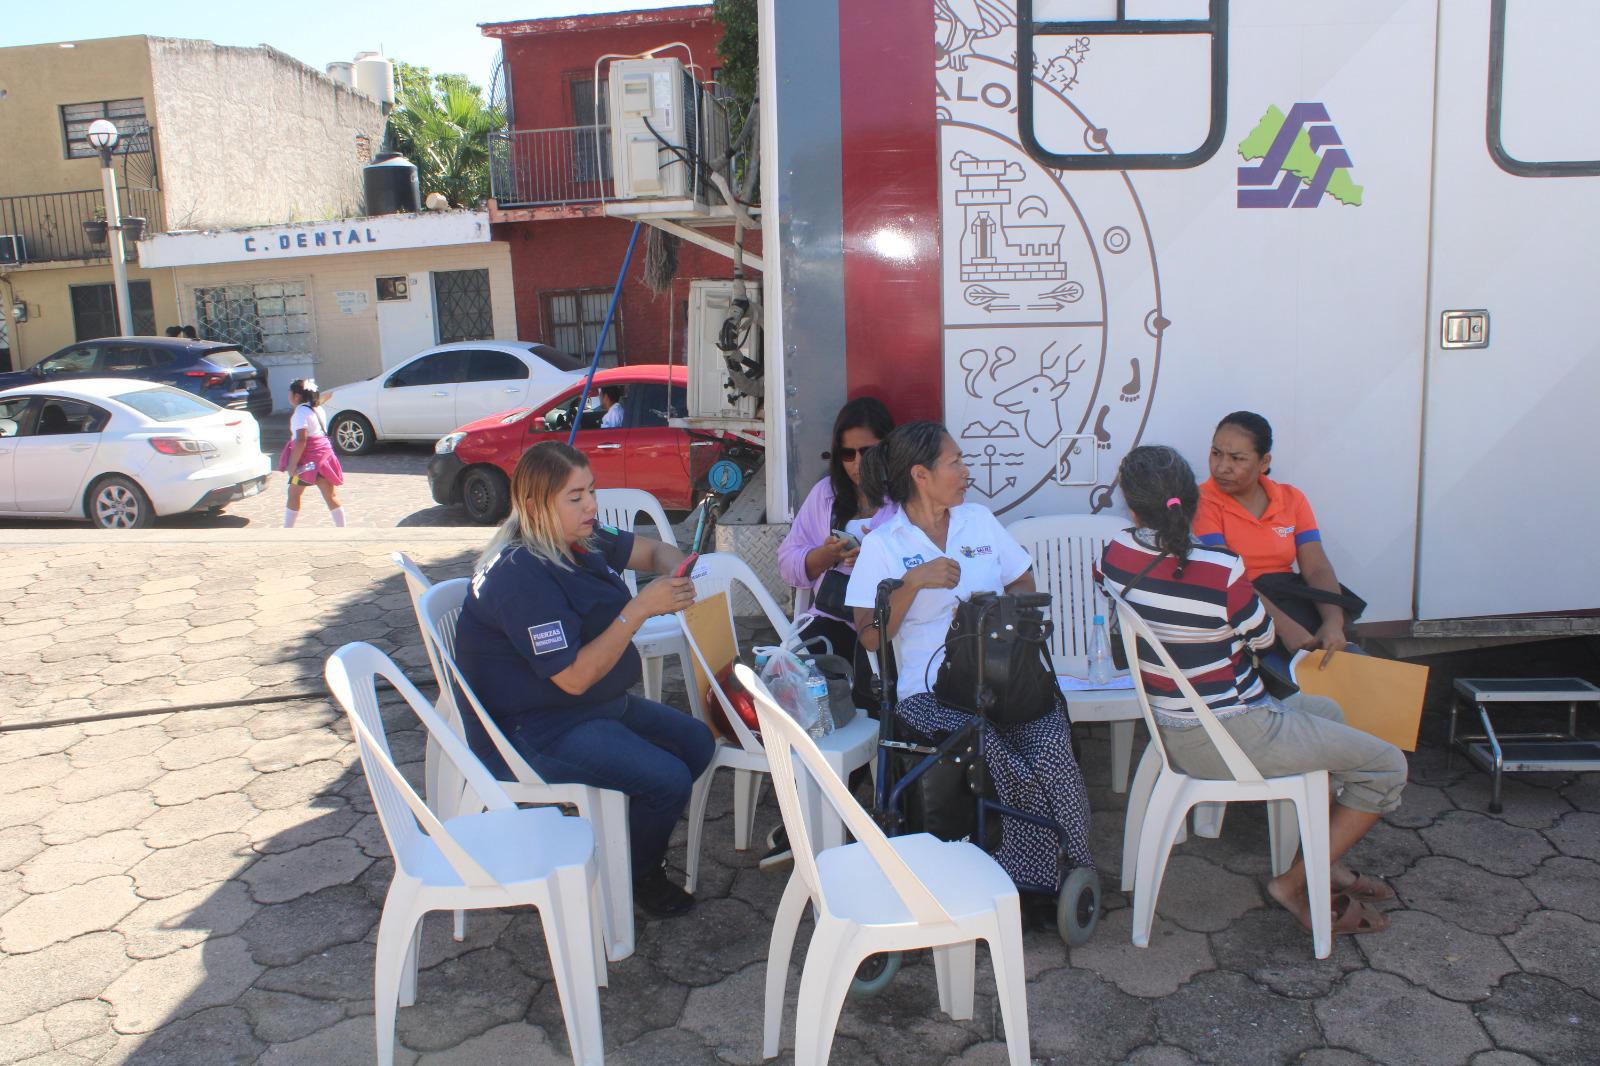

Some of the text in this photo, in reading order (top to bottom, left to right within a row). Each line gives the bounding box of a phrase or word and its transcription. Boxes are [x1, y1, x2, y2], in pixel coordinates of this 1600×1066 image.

[244, 228, 376, 252] C. DENTAL
[533, 629, 561, 641] FUERZAS
